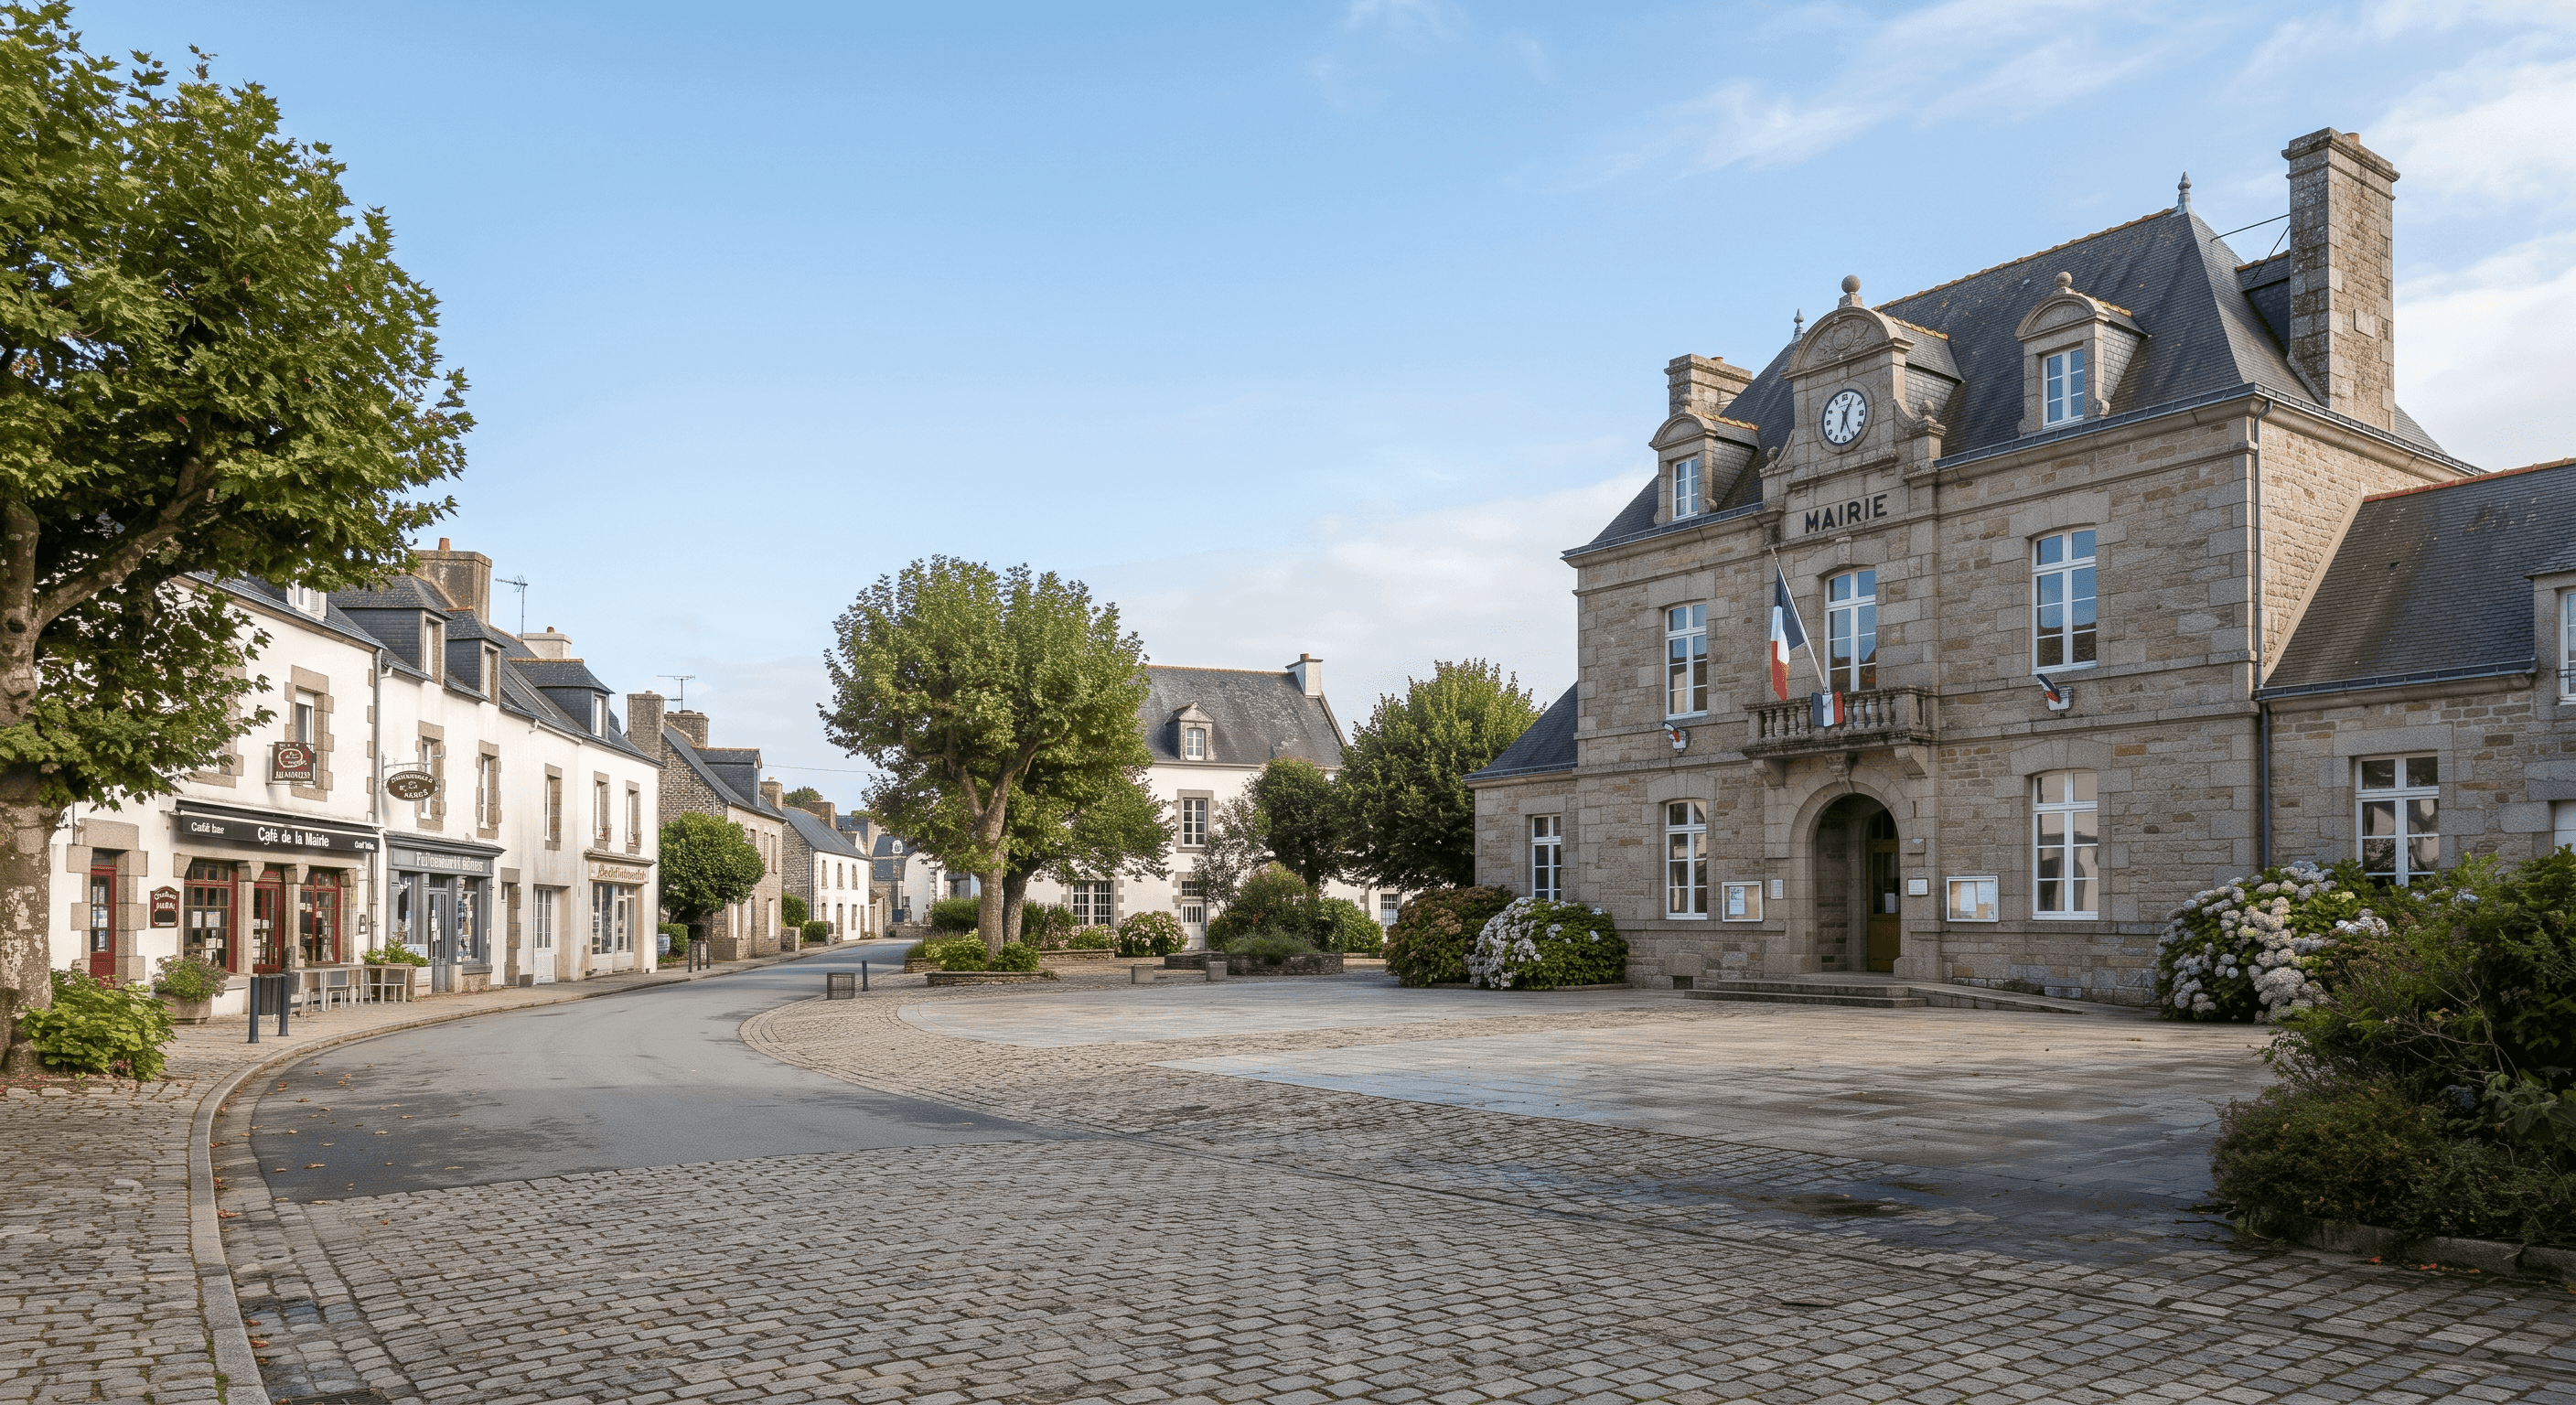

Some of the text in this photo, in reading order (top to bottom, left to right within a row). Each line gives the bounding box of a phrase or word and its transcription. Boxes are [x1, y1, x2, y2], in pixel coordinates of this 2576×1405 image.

[1805, 494, 1887, 534] MAIRIE
[257, 826, 278, 845] Café
[281, 829, 292, 843] de
[295, 831, 303, 845] la
